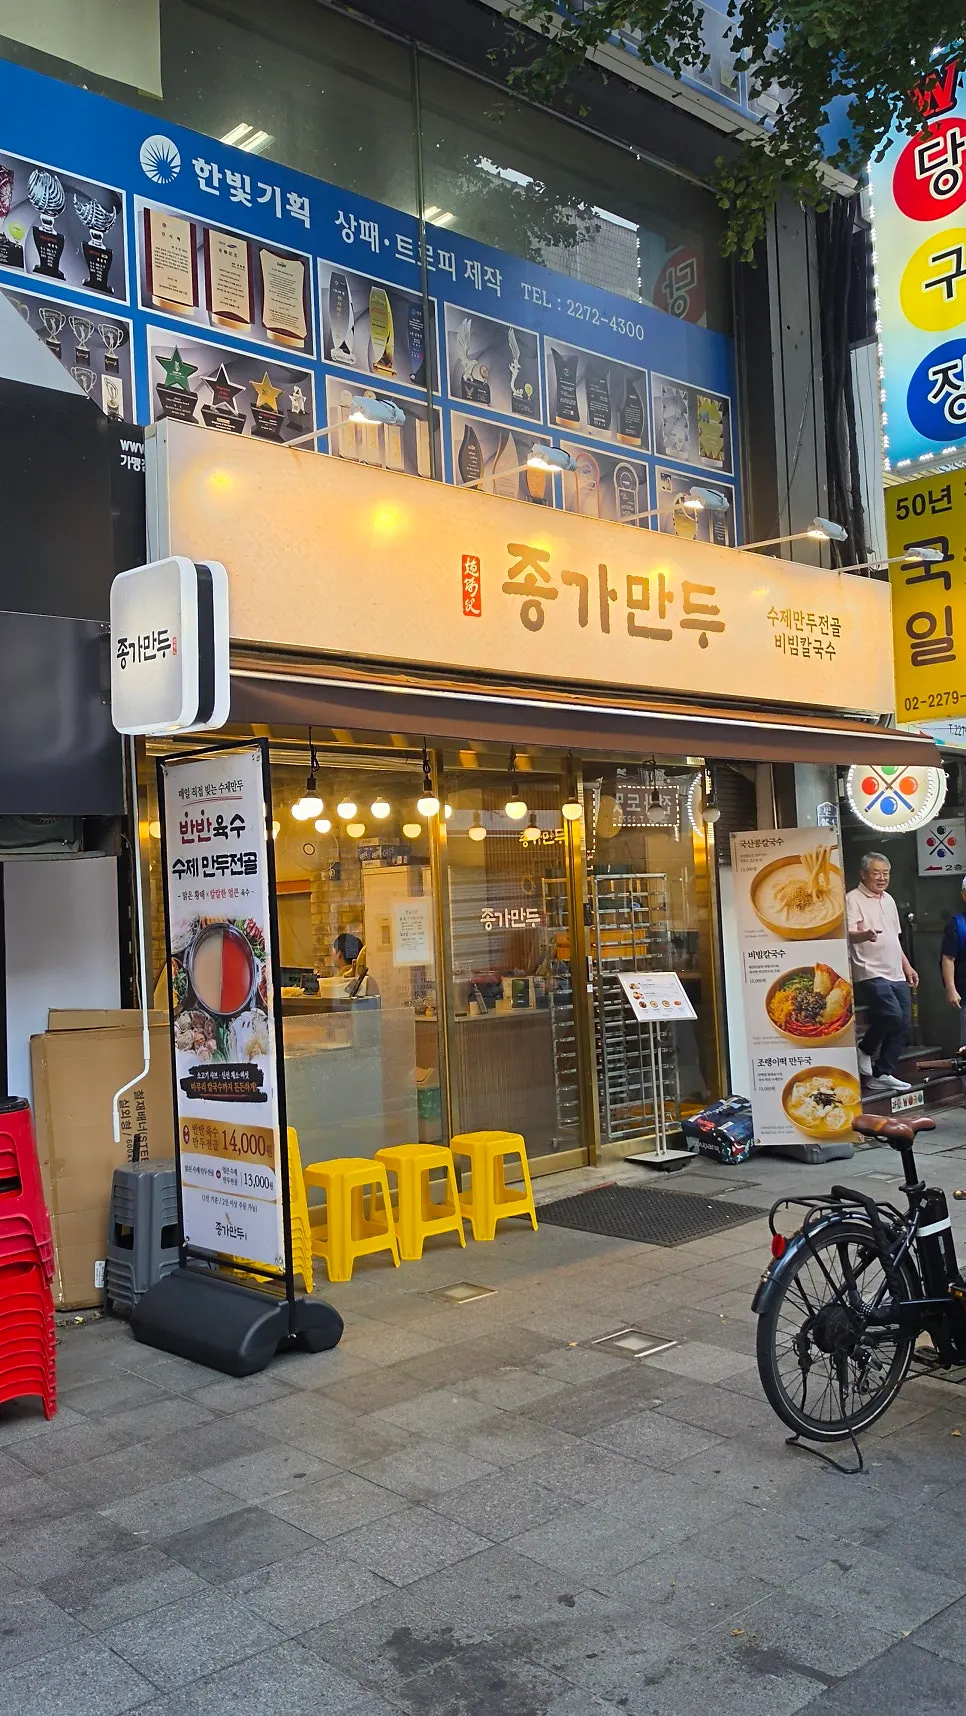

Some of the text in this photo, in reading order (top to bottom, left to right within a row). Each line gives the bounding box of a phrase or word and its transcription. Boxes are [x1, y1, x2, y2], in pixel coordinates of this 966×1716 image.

[191, 157, 311, 229] 한빛기획
[463, 258, 503, 298] 제작
[521, 282, 553, 309] TEL
[566, 299, 645, 342] 2272-4300
[896, 484, 953, 520] 50년
[501, 543, 726, 650] 종가만두
[767, 606, 842, 638] 수제만두전골
[116, 629, 172, 670] 종가만두
[774, 632, 837, 661] 비빔칼국수
[480, 907, 541, 931] 종가만두
[215, 1221, 245, 1240] 종가만두
